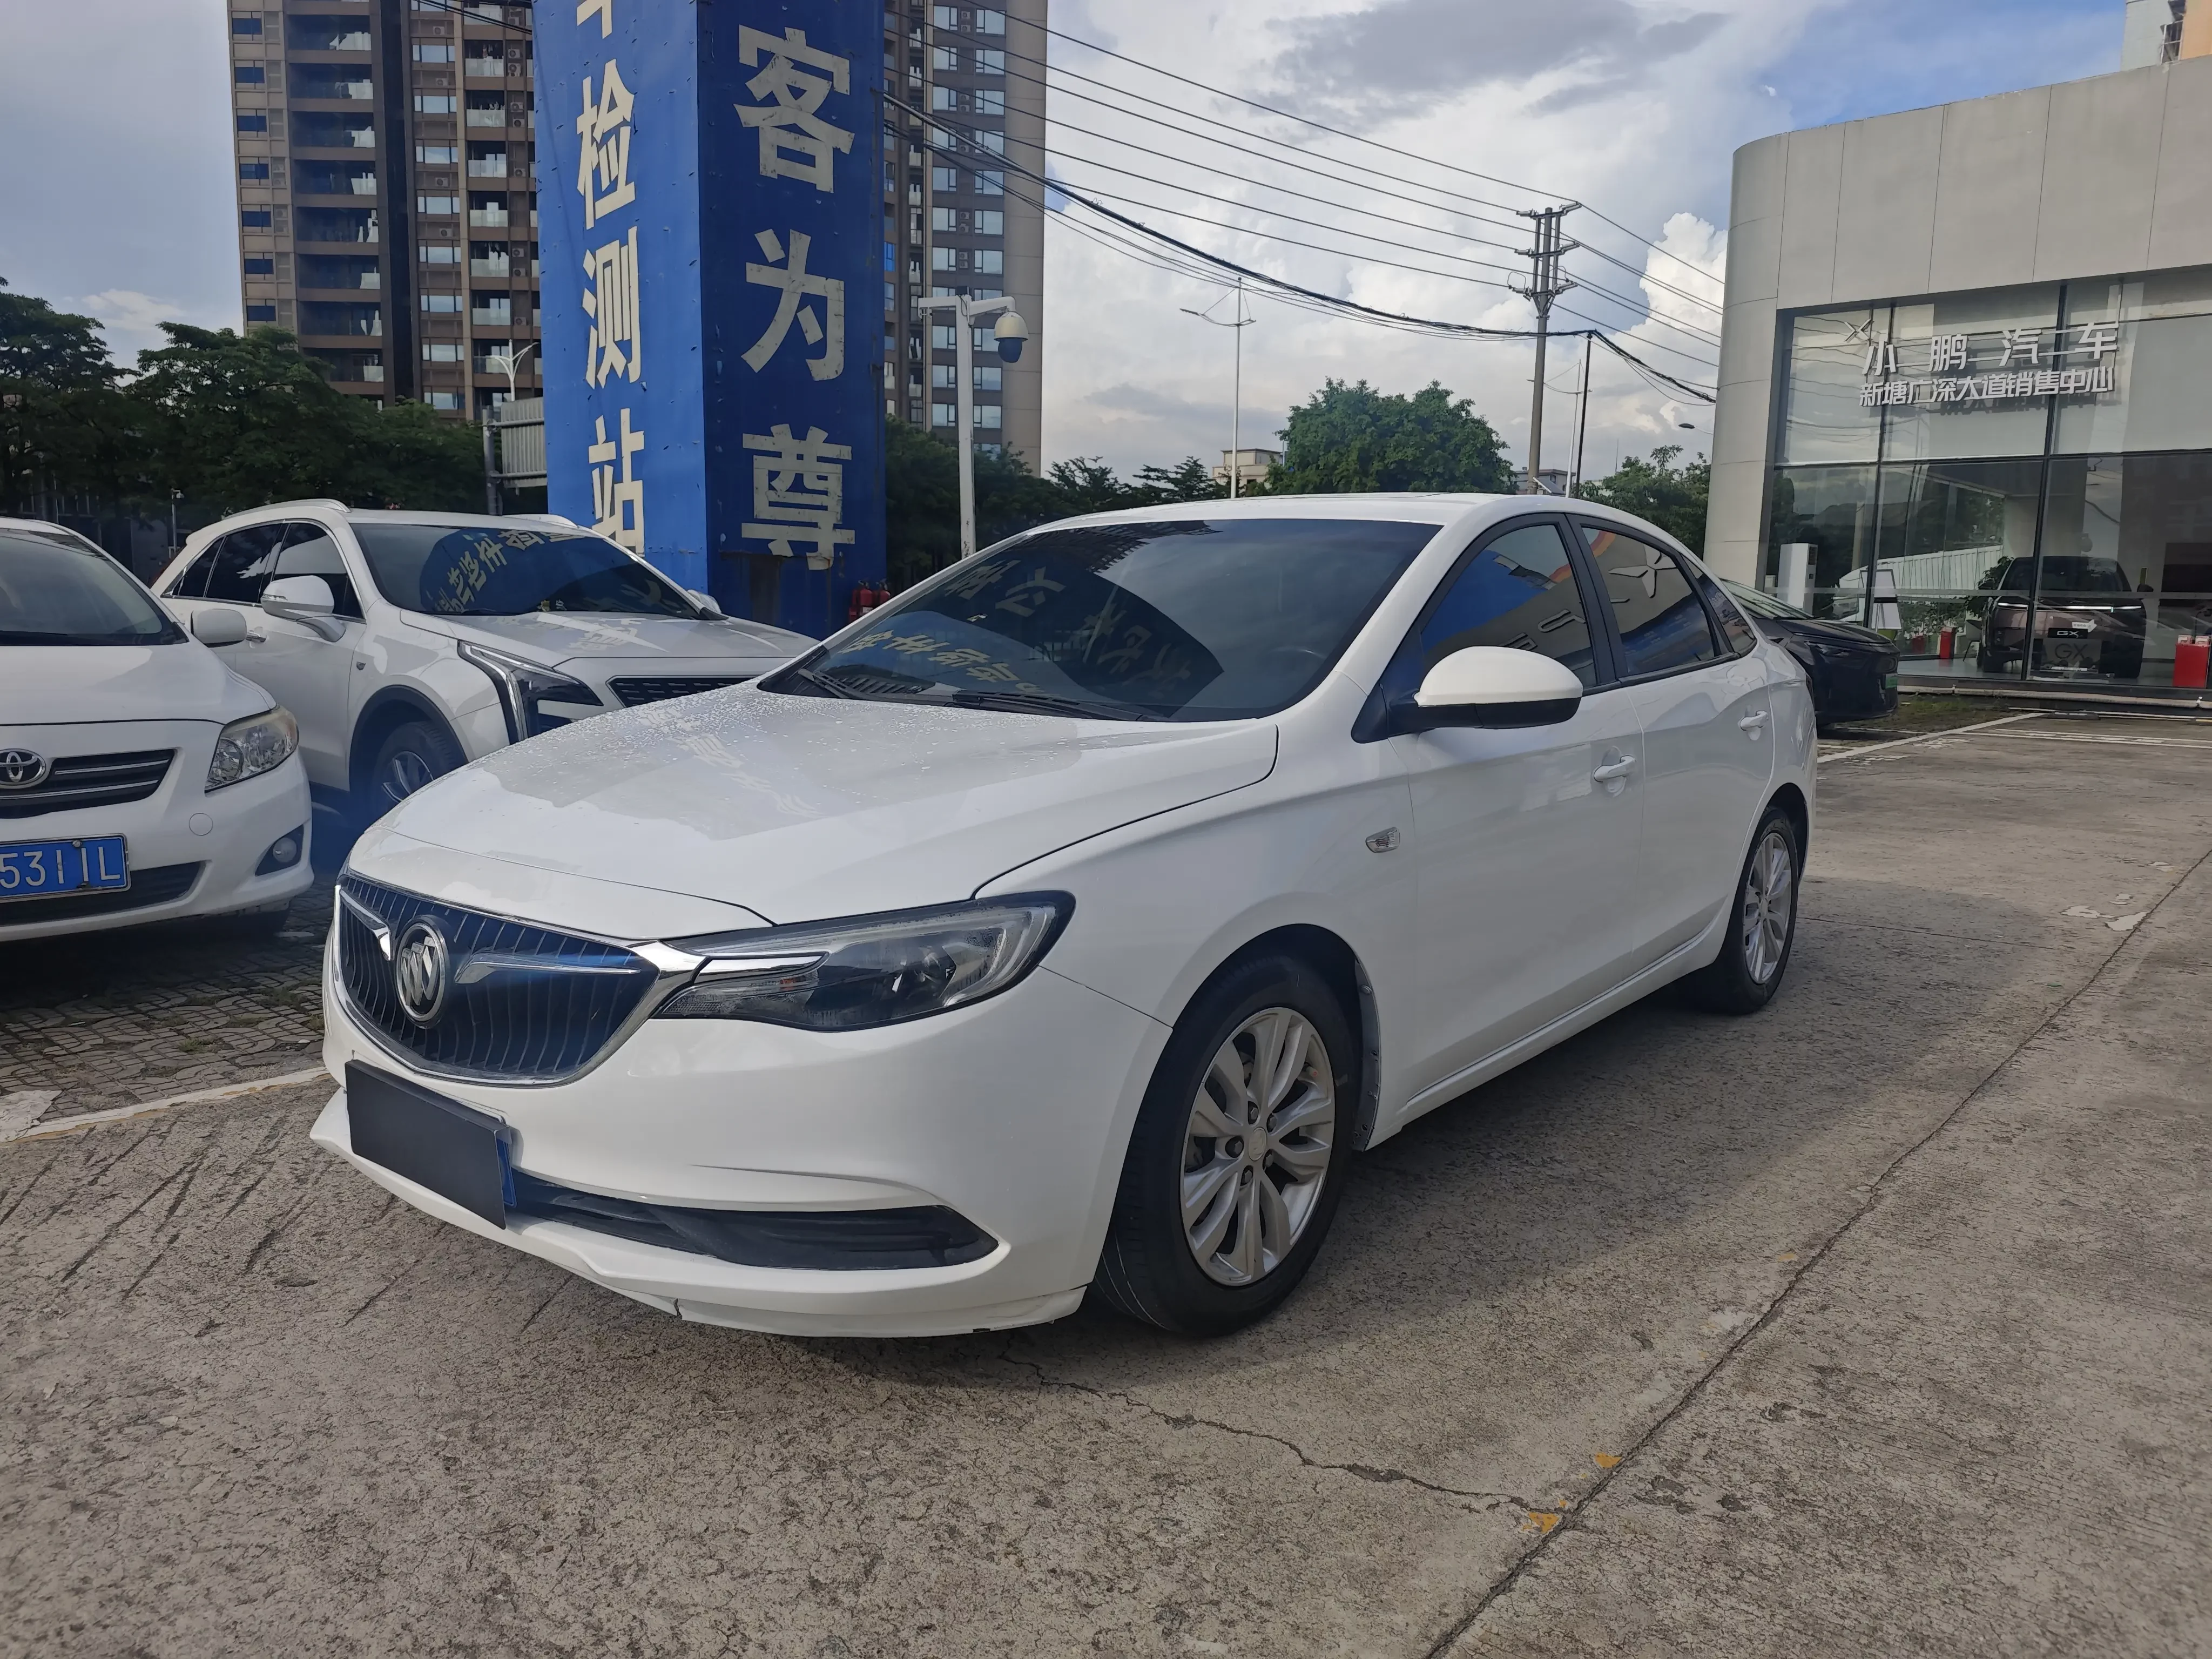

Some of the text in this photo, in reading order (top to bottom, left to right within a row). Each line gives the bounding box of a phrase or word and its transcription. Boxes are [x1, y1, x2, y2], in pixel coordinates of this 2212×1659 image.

[733, 24, 855, 570] 客为尊
[1862, 322, 2119, 375] 小鹏汽车
[1859, 366, 2114, 407] 新塘广深大道销售中心
